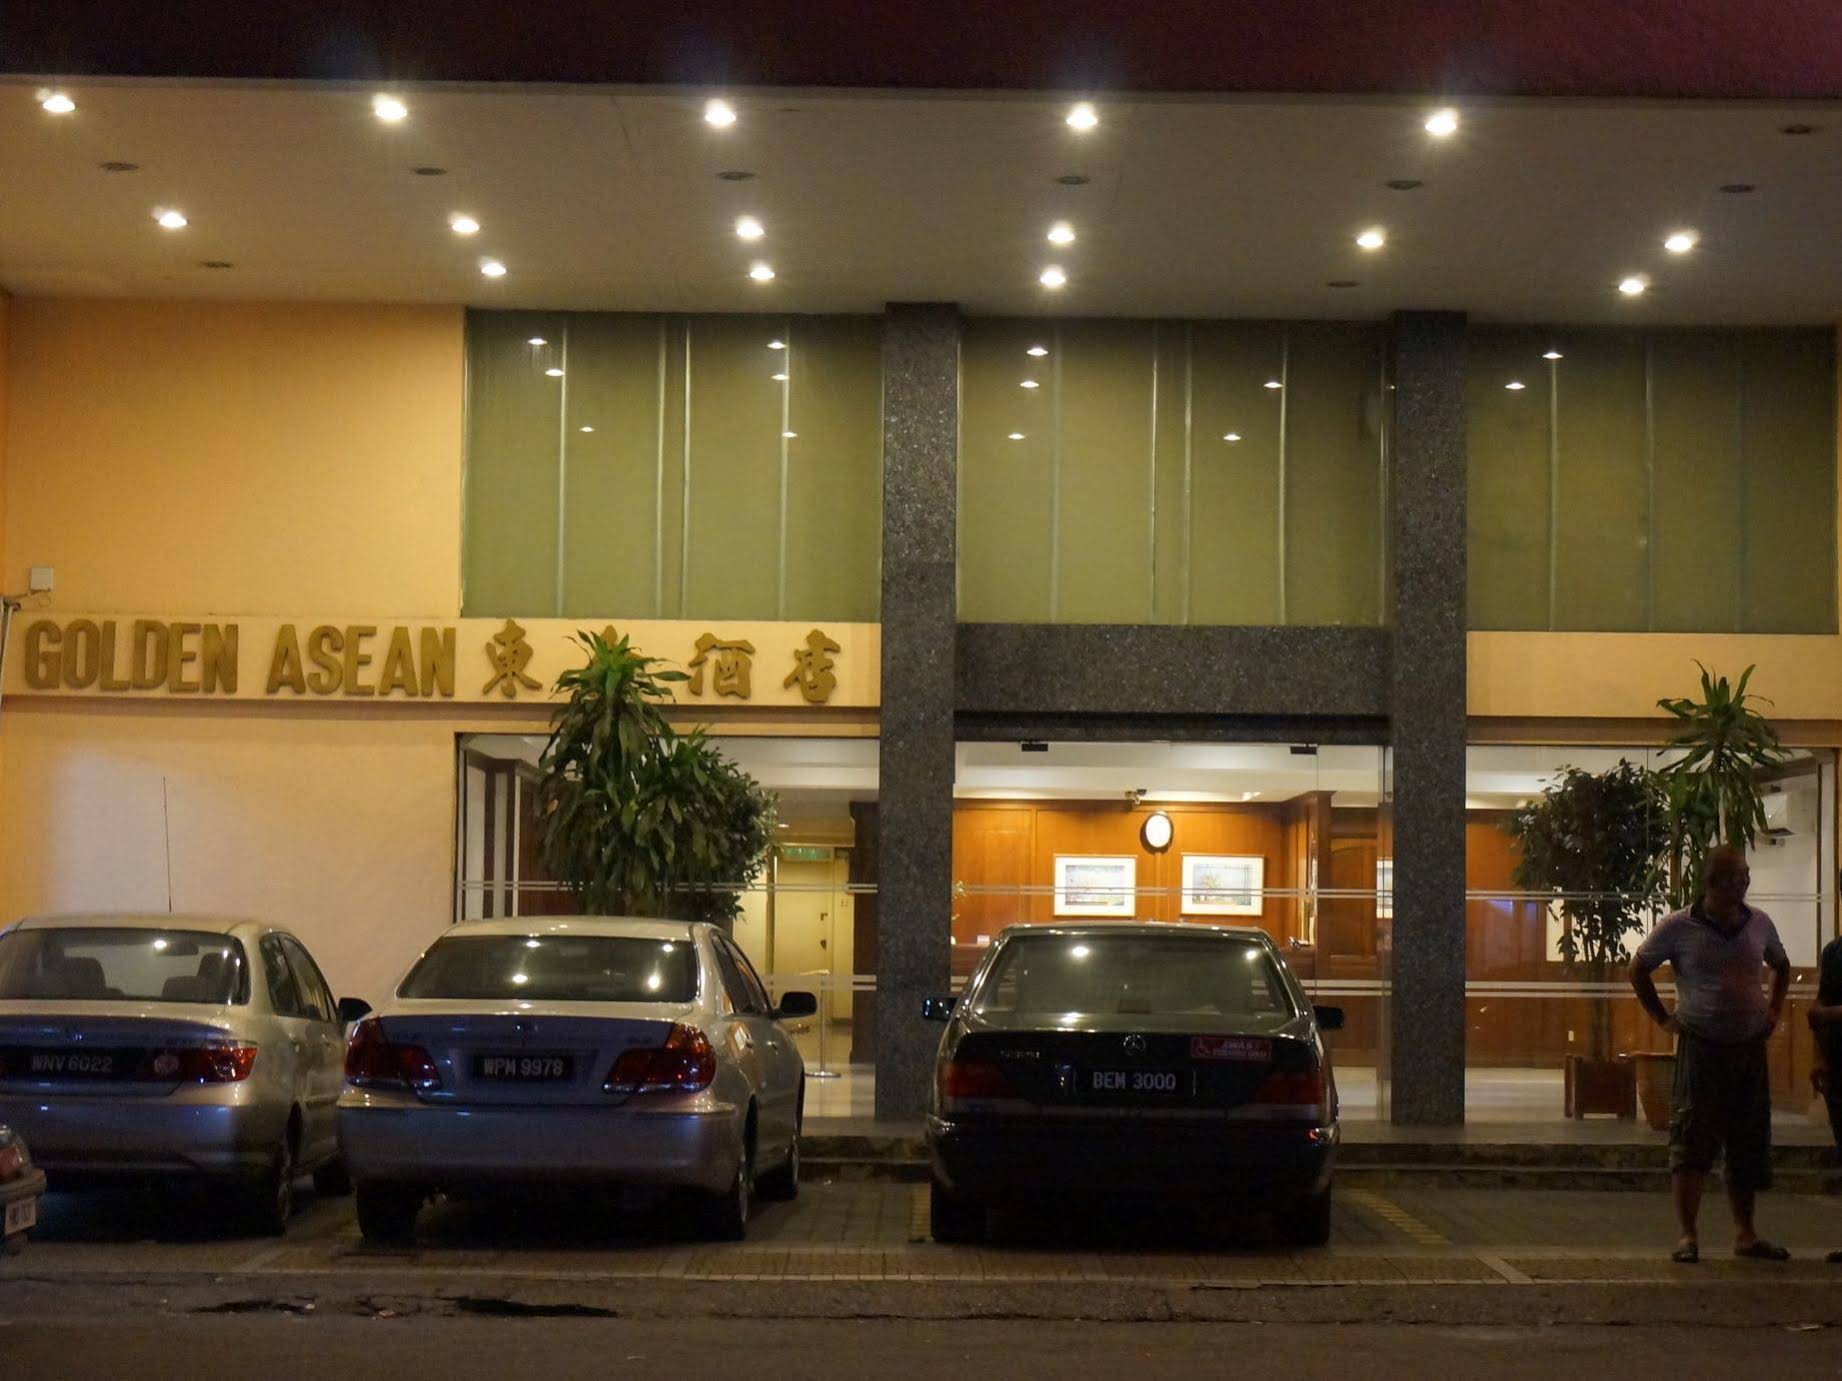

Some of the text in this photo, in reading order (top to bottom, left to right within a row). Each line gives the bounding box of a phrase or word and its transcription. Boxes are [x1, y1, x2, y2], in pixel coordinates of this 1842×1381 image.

[25, 619, 457, 697] GOLDEN ASEAN
[483, 618, 841, 703] 東酒店
[484, 1058, 563, 1075] WPM 9978
[1093, 1072, 1176, 1089] BEM 3000
